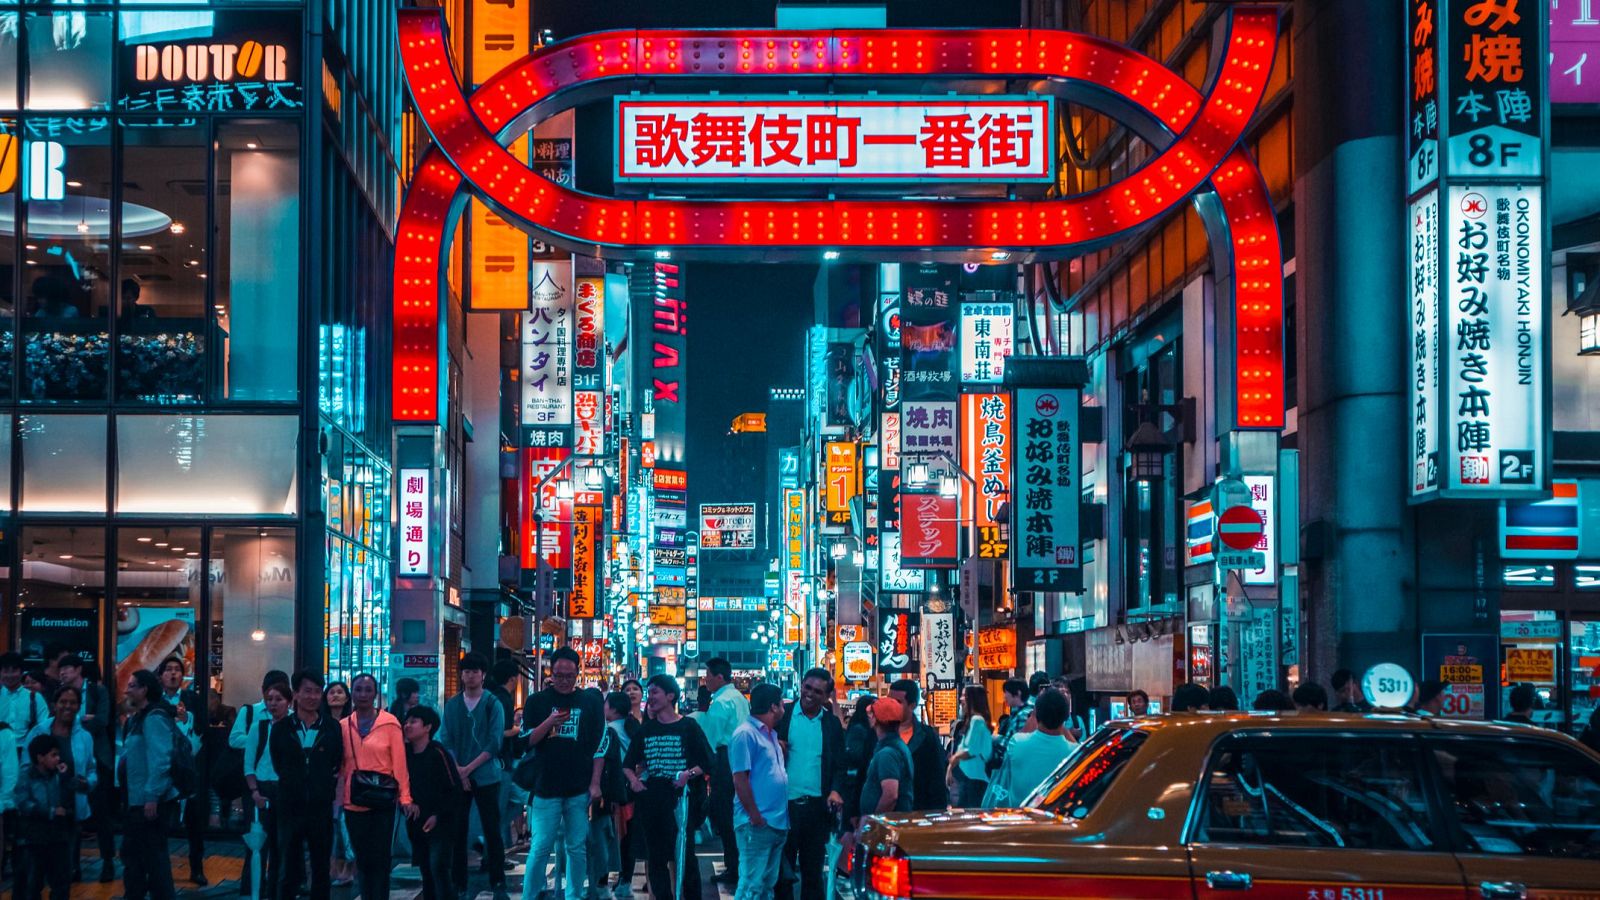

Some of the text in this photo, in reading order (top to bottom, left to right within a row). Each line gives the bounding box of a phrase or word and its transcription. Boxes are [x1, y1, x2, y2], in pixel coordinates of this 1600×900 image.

[136, 40, 287, 81] DOUTOR
[1414, 97, 1437, 139] 本陣
[1457, 88, 1532, 124] 本陣
[635, 112, 1033, 169] 歌舞伎町一番街
[1468, 134, 1522, 168] 8F
[1417, 148, 1434, 180] 8F
[1496, 198, 1511, 281] 歌舞伎町名物
[1516, 198, 1532, 386] OKONOMIYAKI HONJIN
[576, 281, 597, 368] まぐろ商店
[1456, 220, 1492, 454] お好み焼き本陣
[529, 307, 553, 392] バンタイ
[556, 307, 567, 386] タイ国料理専門店
[974, 318, 992, 381] 東南荘
[1414, 234, 1427, 460] お好み焼き本陣
[537, 412, 556, 422] 3F
[530, 430, 564, 447] 焼肉
[980, 395, 1007, 522] 焼鳥釜めし
[1502, 455, 1533, 478] 2F
[577, 493, 596, 504] 4F
[832, 475, 846, 508] 1
[1025, 417, 1054, 558] お好み焼本陣
[405, 476, 424, 567] 劇場通り
[832, 512, 851, 523] 4F
[917, 496, 942, 557] ステップ
[980, 544, 1008, 558] 2F
[31, 617, 89, 627] information
[1508, 649, 1553, 660] ATM
[940, 682, 955, 690] B1F
[1378, 677, 1408, 693] 5311
[1443, 693, 1471, 715] 30
[1341, 887, 1384, 900] 5311
